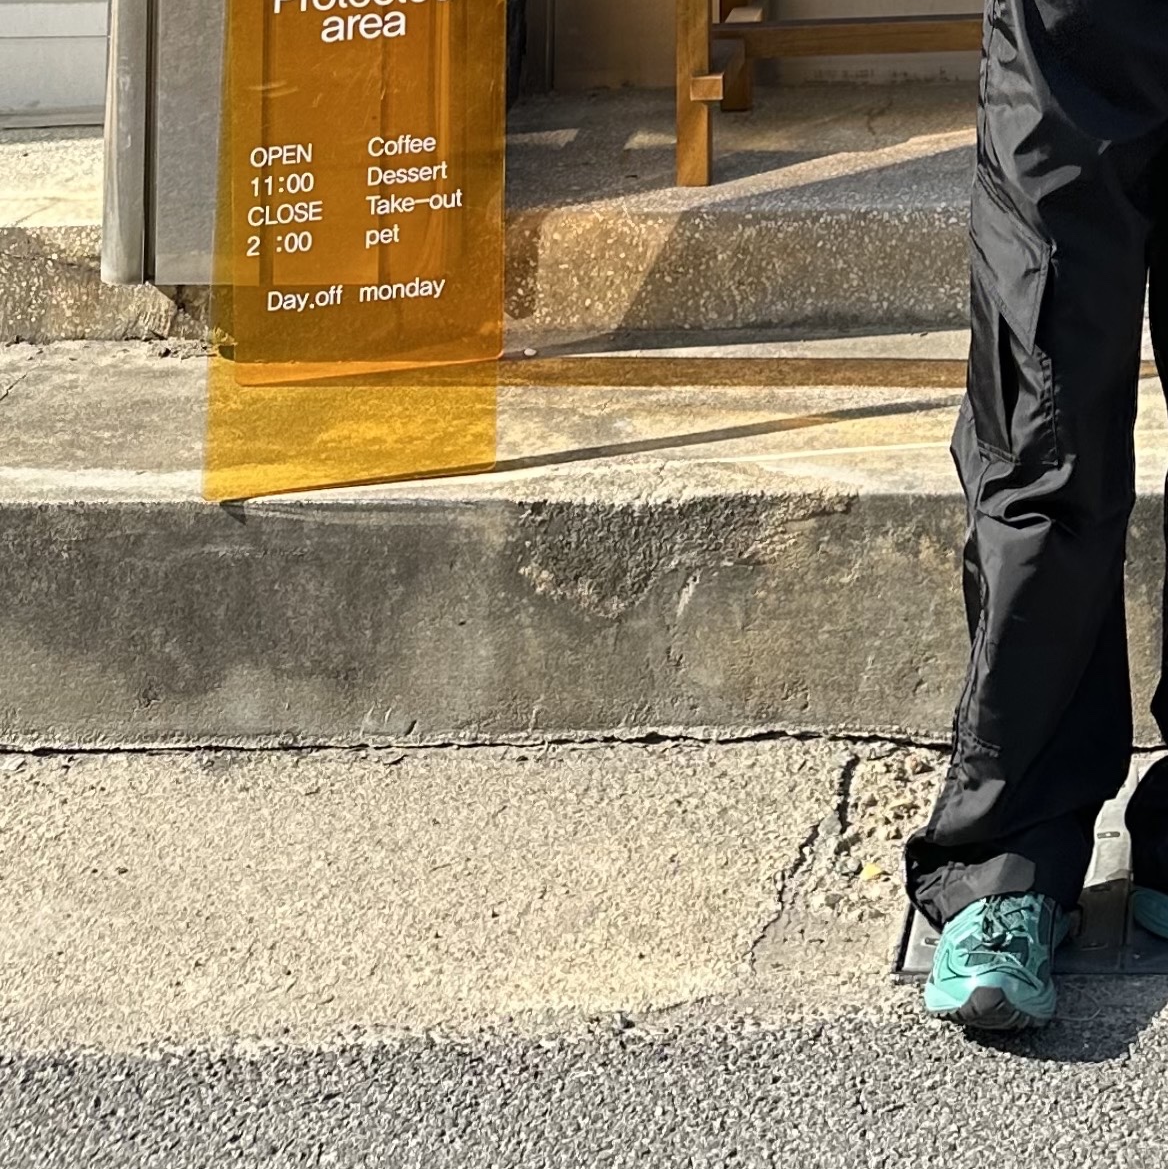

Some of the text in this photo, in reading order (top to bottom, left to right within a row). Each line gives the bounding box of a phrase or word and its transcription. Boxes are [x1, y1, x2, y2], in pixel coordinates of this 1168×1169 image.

[321, 11, 406, 43] area
[250, 142, 313, 168] OPEN
[367, 134, 437, 157] Coffee
[251, 172, 314, 197] 11:00
[367, 161, 448, 186] Dessert
[247, 201, 323, 227] CLOSE
[365, 188, 463, 215] Take-out
[365, 224, 400, 249] pet
[266, 277, 446, 312] Day.off monday
